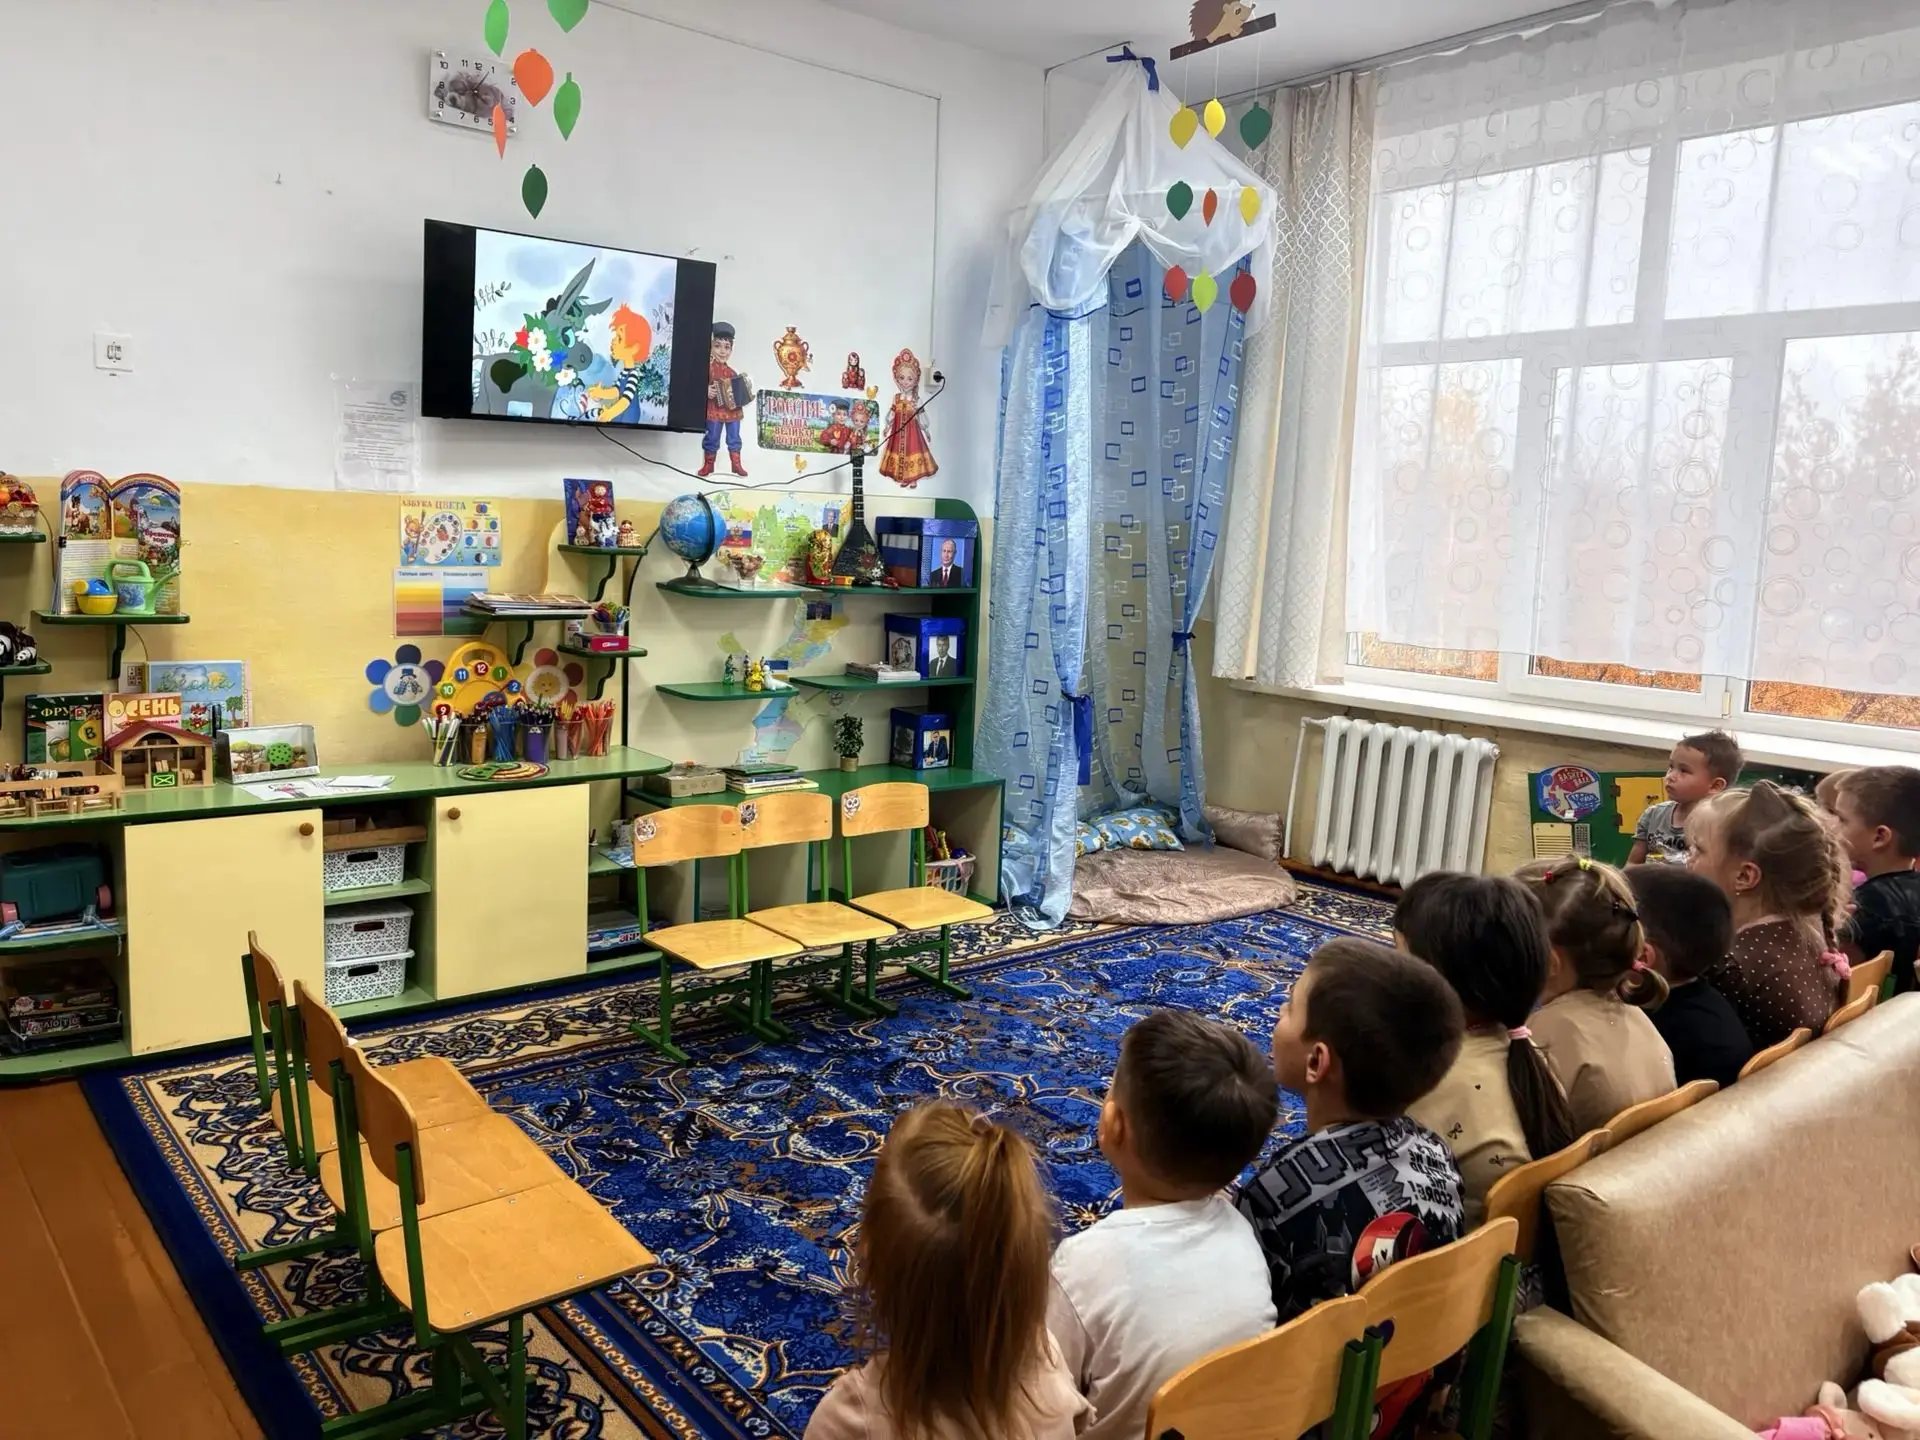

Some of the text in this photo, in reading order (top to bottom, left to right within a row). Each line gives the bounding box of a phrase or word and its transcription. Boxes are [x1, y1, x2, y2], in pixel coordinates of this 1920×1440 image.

[440, 61, 448, 70] 10
[461, 59, 468, 68] 11
[474, 62, 482, 71] 12
[782, 417, 808, 428] НАША
[436, 500, 466, 510] ЦВЕТА
[477, 664, 486, 674] 12
[458, 671, 466, 680] 11
[444, 686, 453, 695] 10
[512, 682, 518, 692] 2
[108, 699, 180, 718] ОСЕНЬ
